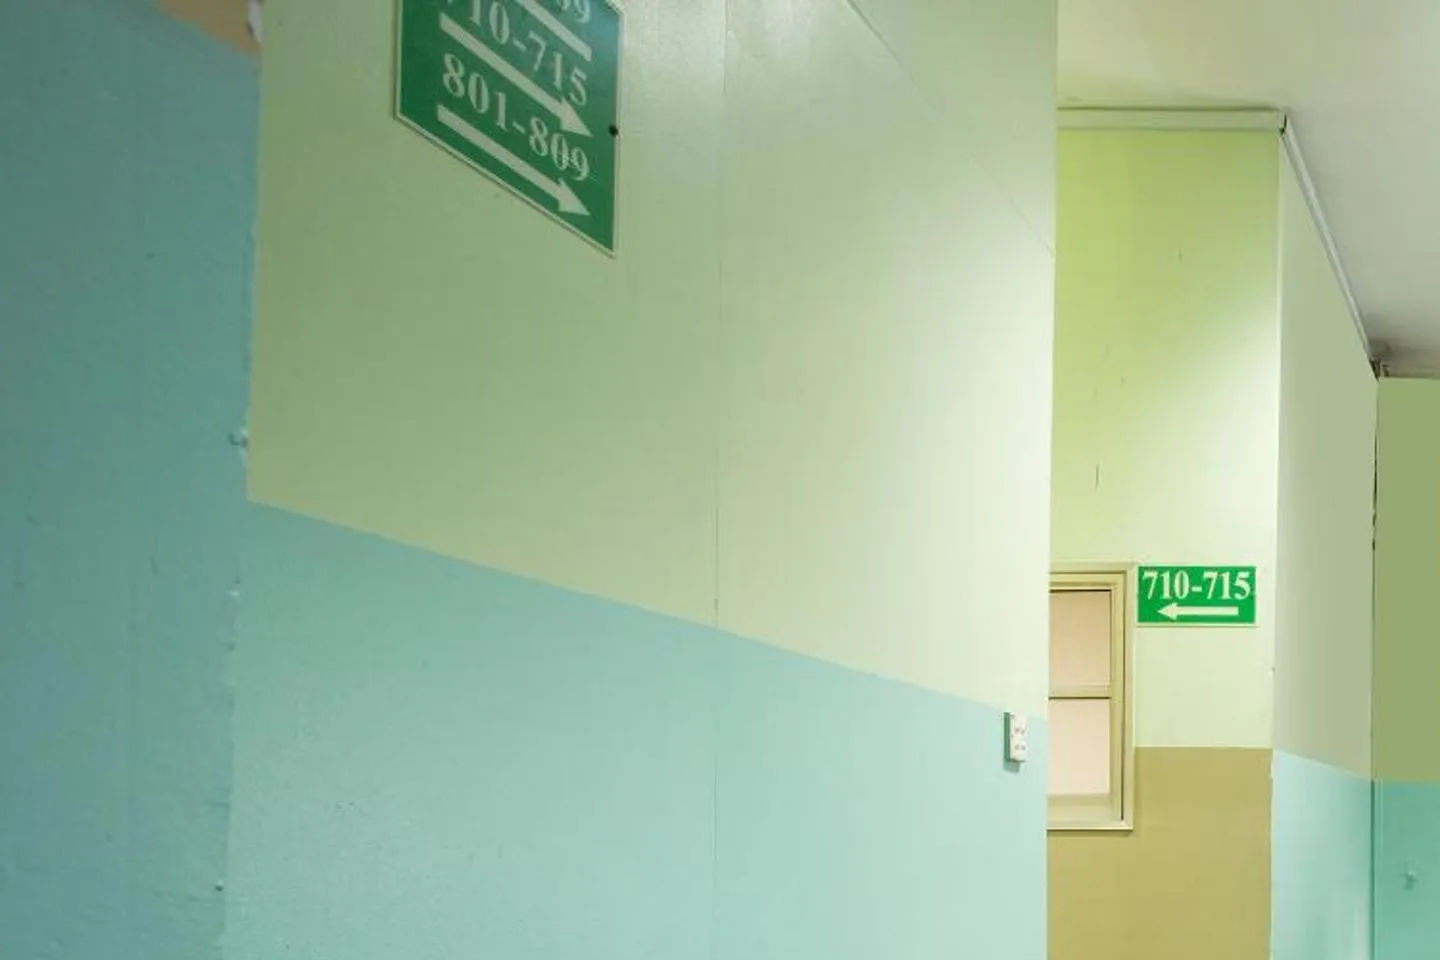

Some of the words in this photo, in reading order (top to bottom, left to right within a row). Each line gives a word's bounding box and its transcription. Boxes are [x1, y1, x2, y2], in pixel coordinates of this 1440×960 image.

[448, 0, 587, 106] 10-715
[442, 53, 590, 182] 801-809
[1142, 570, 1251, 600] 710-715
